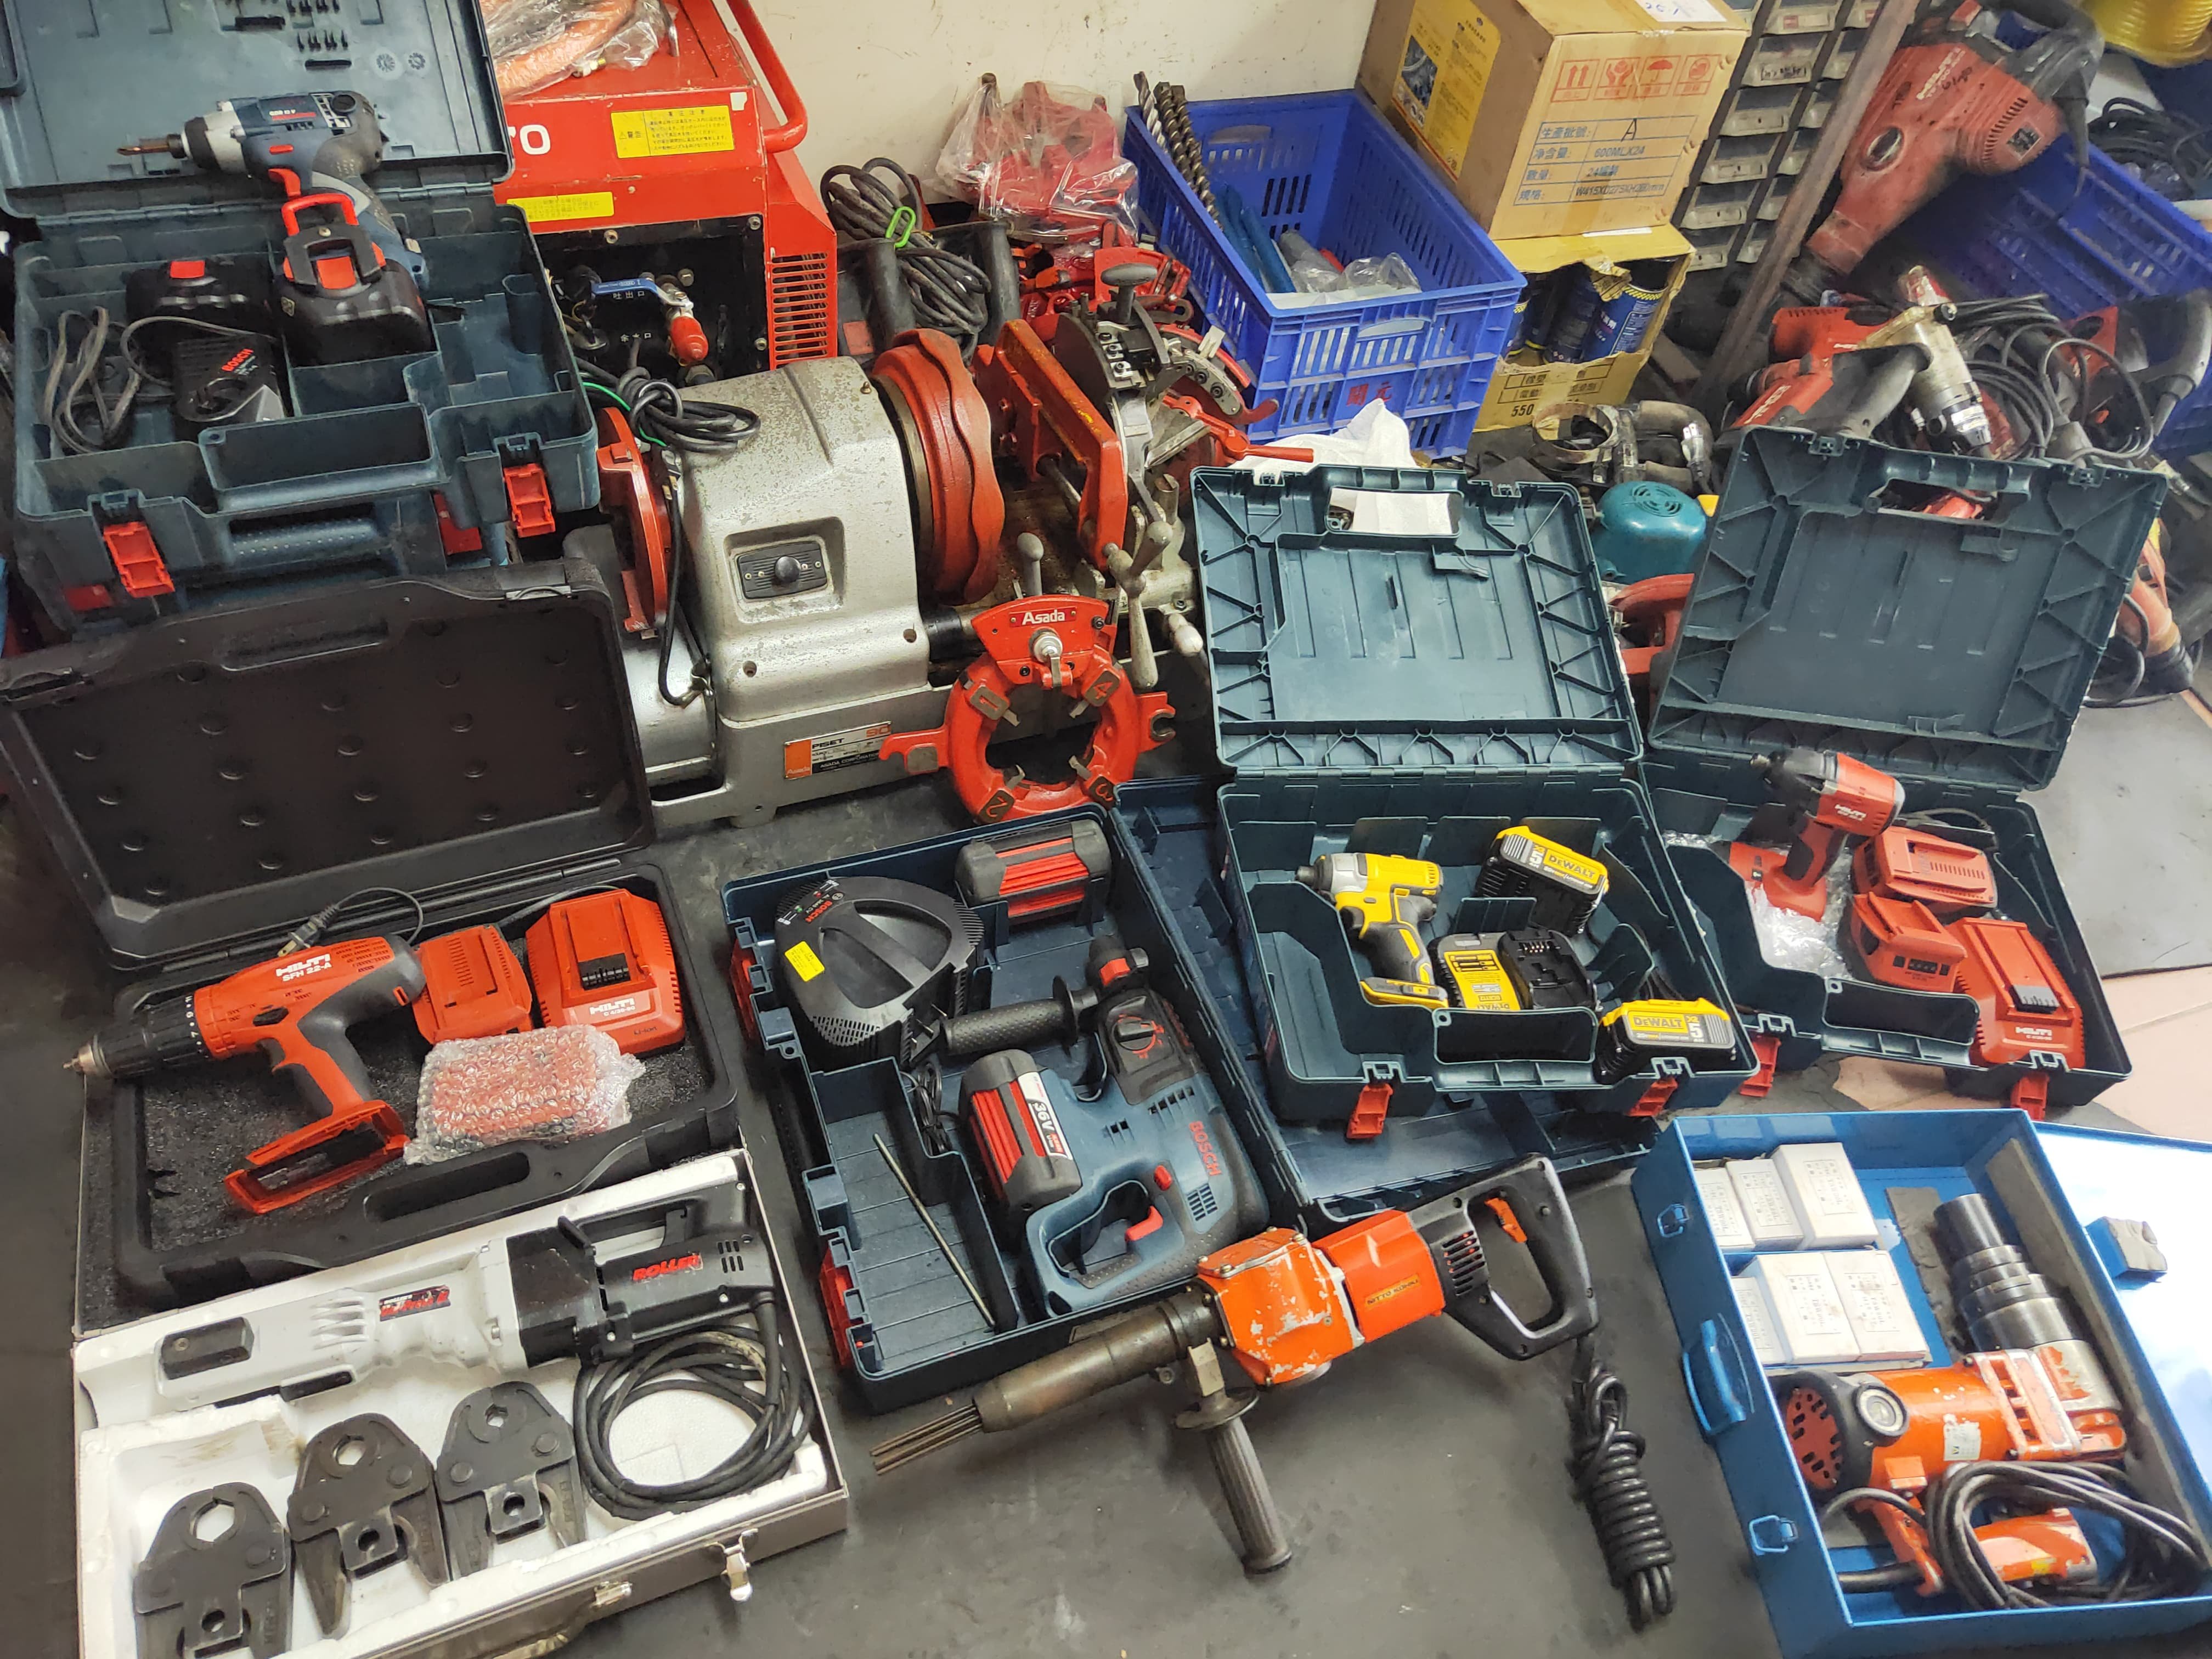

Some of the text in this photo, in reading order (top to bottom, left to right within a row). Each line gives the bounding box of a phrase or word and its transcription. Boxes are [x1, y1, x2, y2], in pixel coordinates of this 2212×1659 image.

[1621, 118, 1638, 142] A
[221, 348, 254, 372] BOSCH
[1511, 403, 1534, 417] 550
[1022, 608, 1065, 625] Asada
[812, 737, 845, 749] PISET
[1529, 850, 1544, 865] 5
[805, 900, 833, 923] BOSCH
[275, 953, 331, 977] HILTI
[282, 962, 332, 982] SFH 22-A
[589, 997, 635, 1015] HILTI
[1688, 1023, 1703, 1039] 5
[2015, 1026, 2052, 1036] HILTI
[1032, 1102, 1055, 1131] 36V
[1188, 1120, 1223, 1176] BOSCH
[633, 1255, 701, 1282] ROLLER
